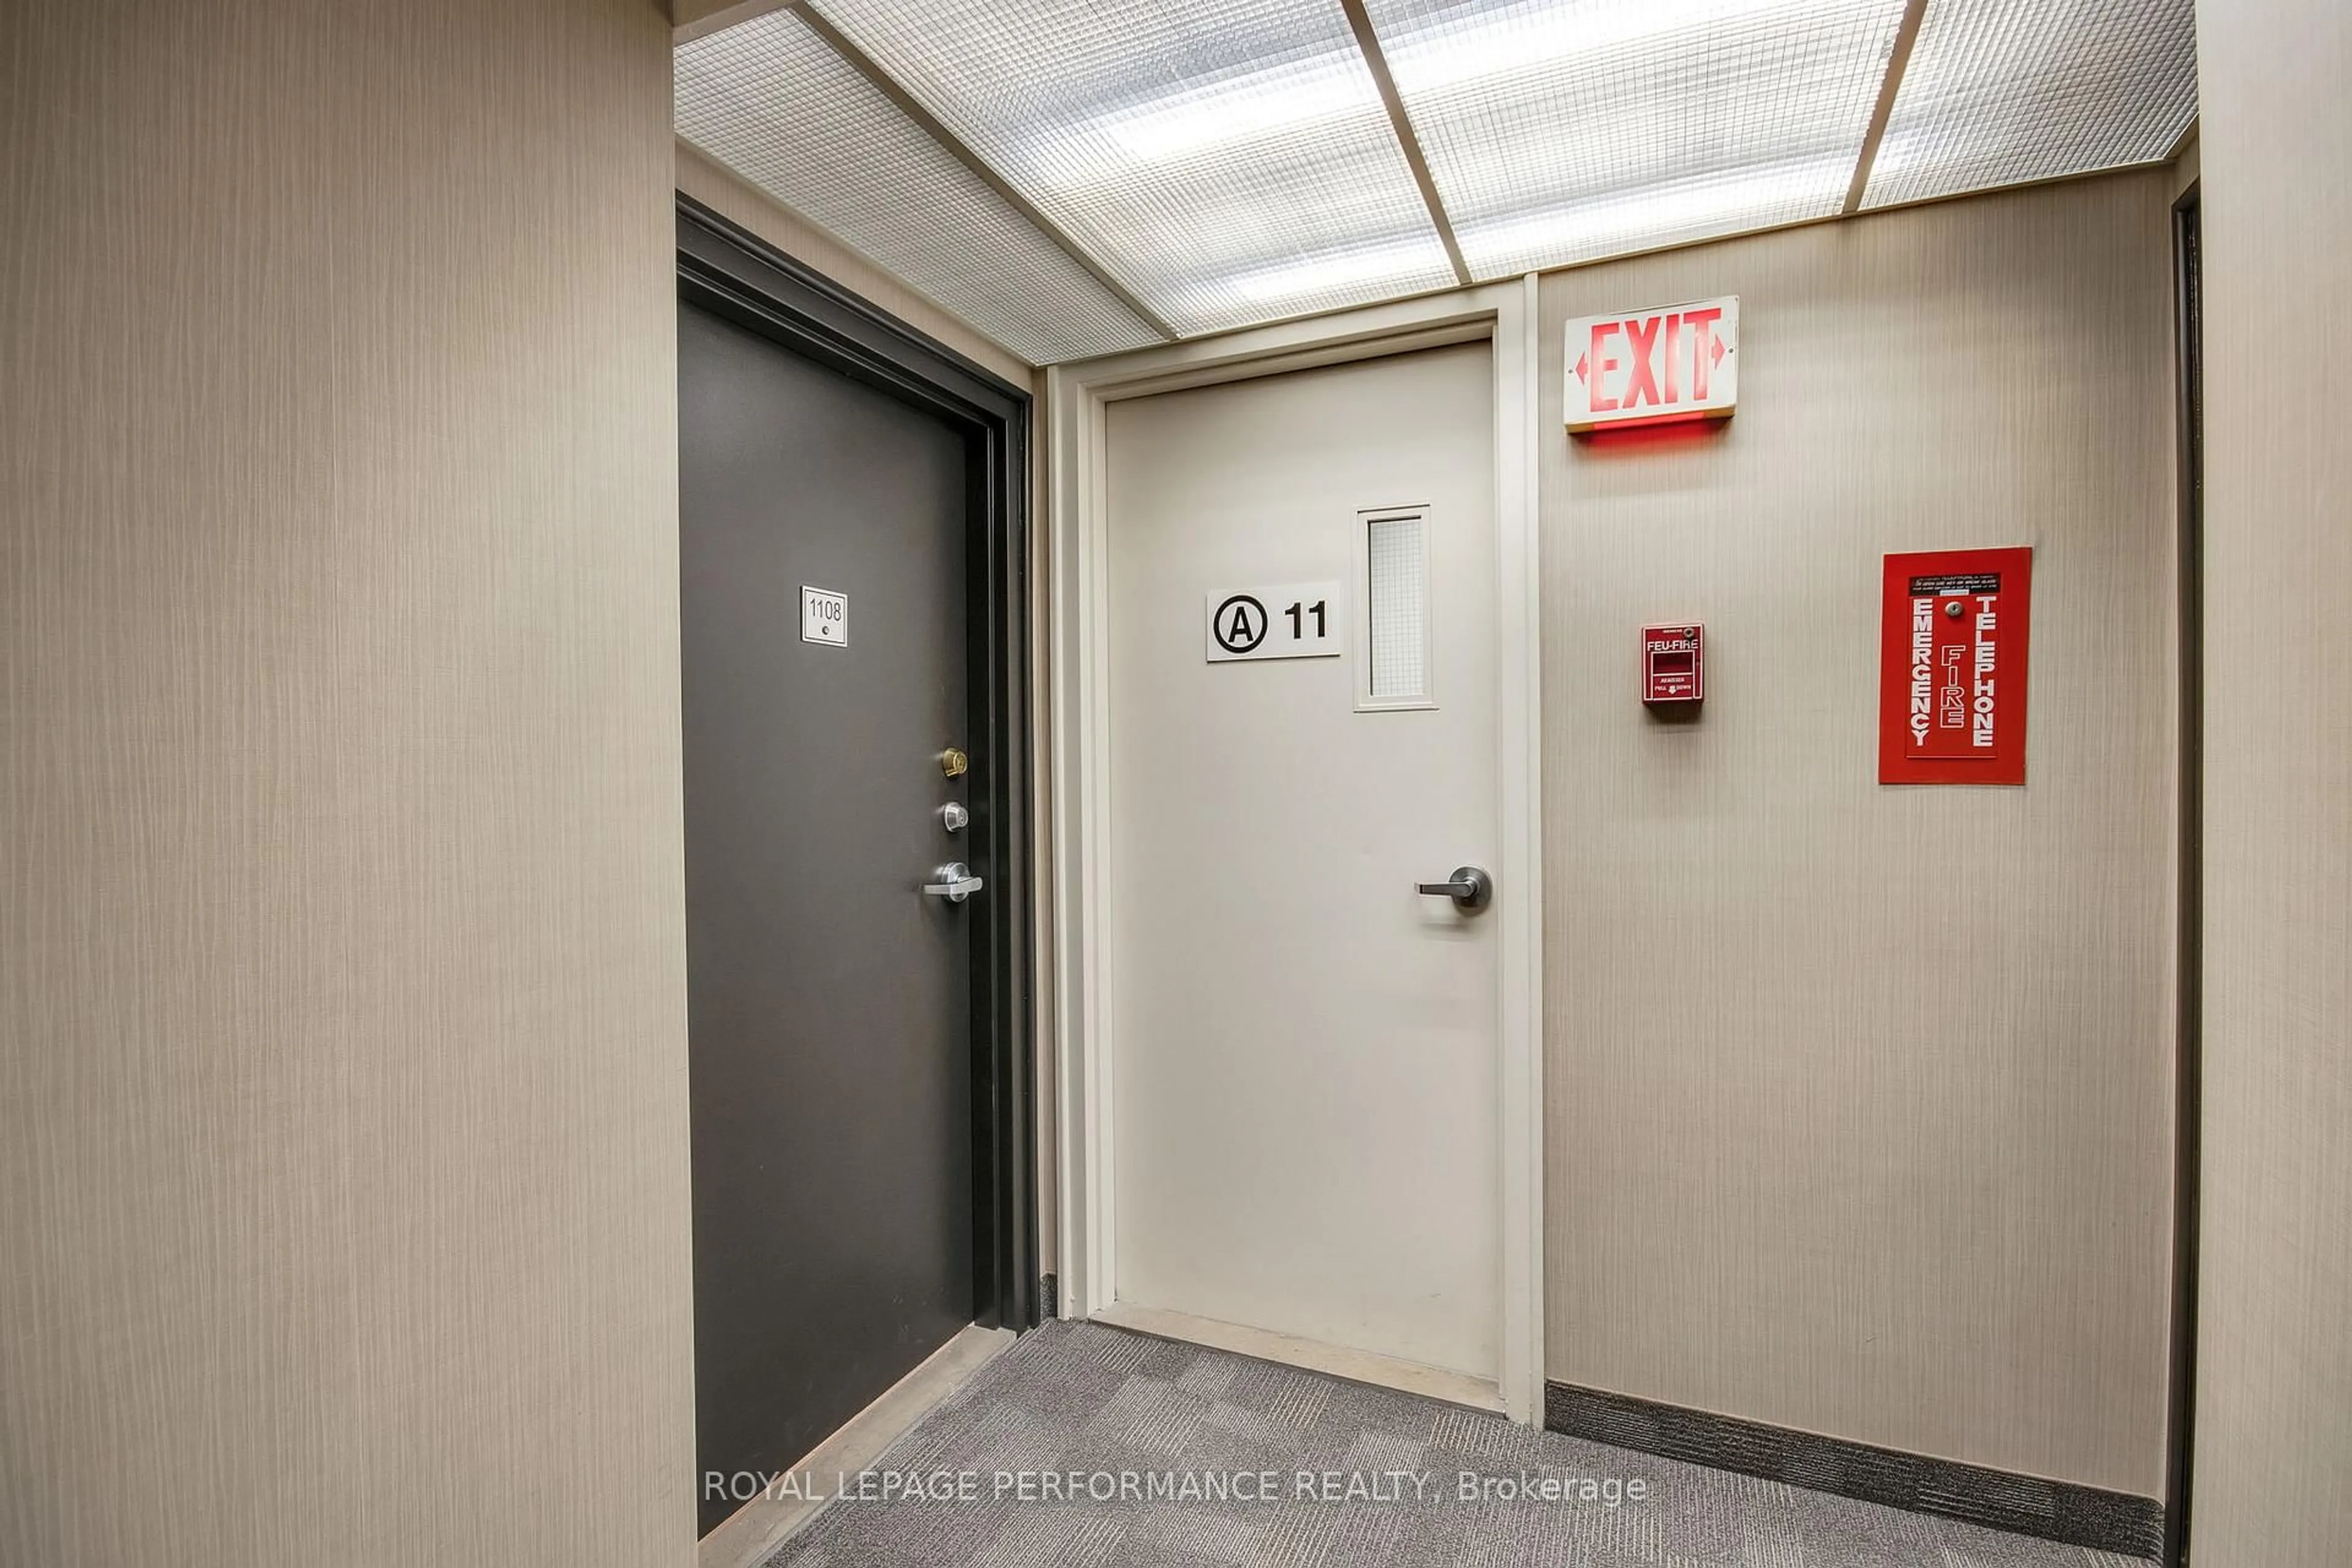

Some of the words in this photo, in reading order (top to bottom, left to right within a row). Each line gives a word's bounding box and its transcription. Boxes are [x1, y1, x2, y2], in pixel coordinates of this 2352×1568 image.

[1590, 307, 1721, 412] EXIT
[810, 598, 841, 621] 1108
[1228, 606, 1254, 643] A
[1285, 600, 1325, 639] 11
[1647, 639, 1698, 652] FEU-FIRE
[1910, 598, 1933, 747] EMERGENCY
[1940, 645, 1966, 729] FIRE
[1973, 596, 1997, 747] TELEPHONE
